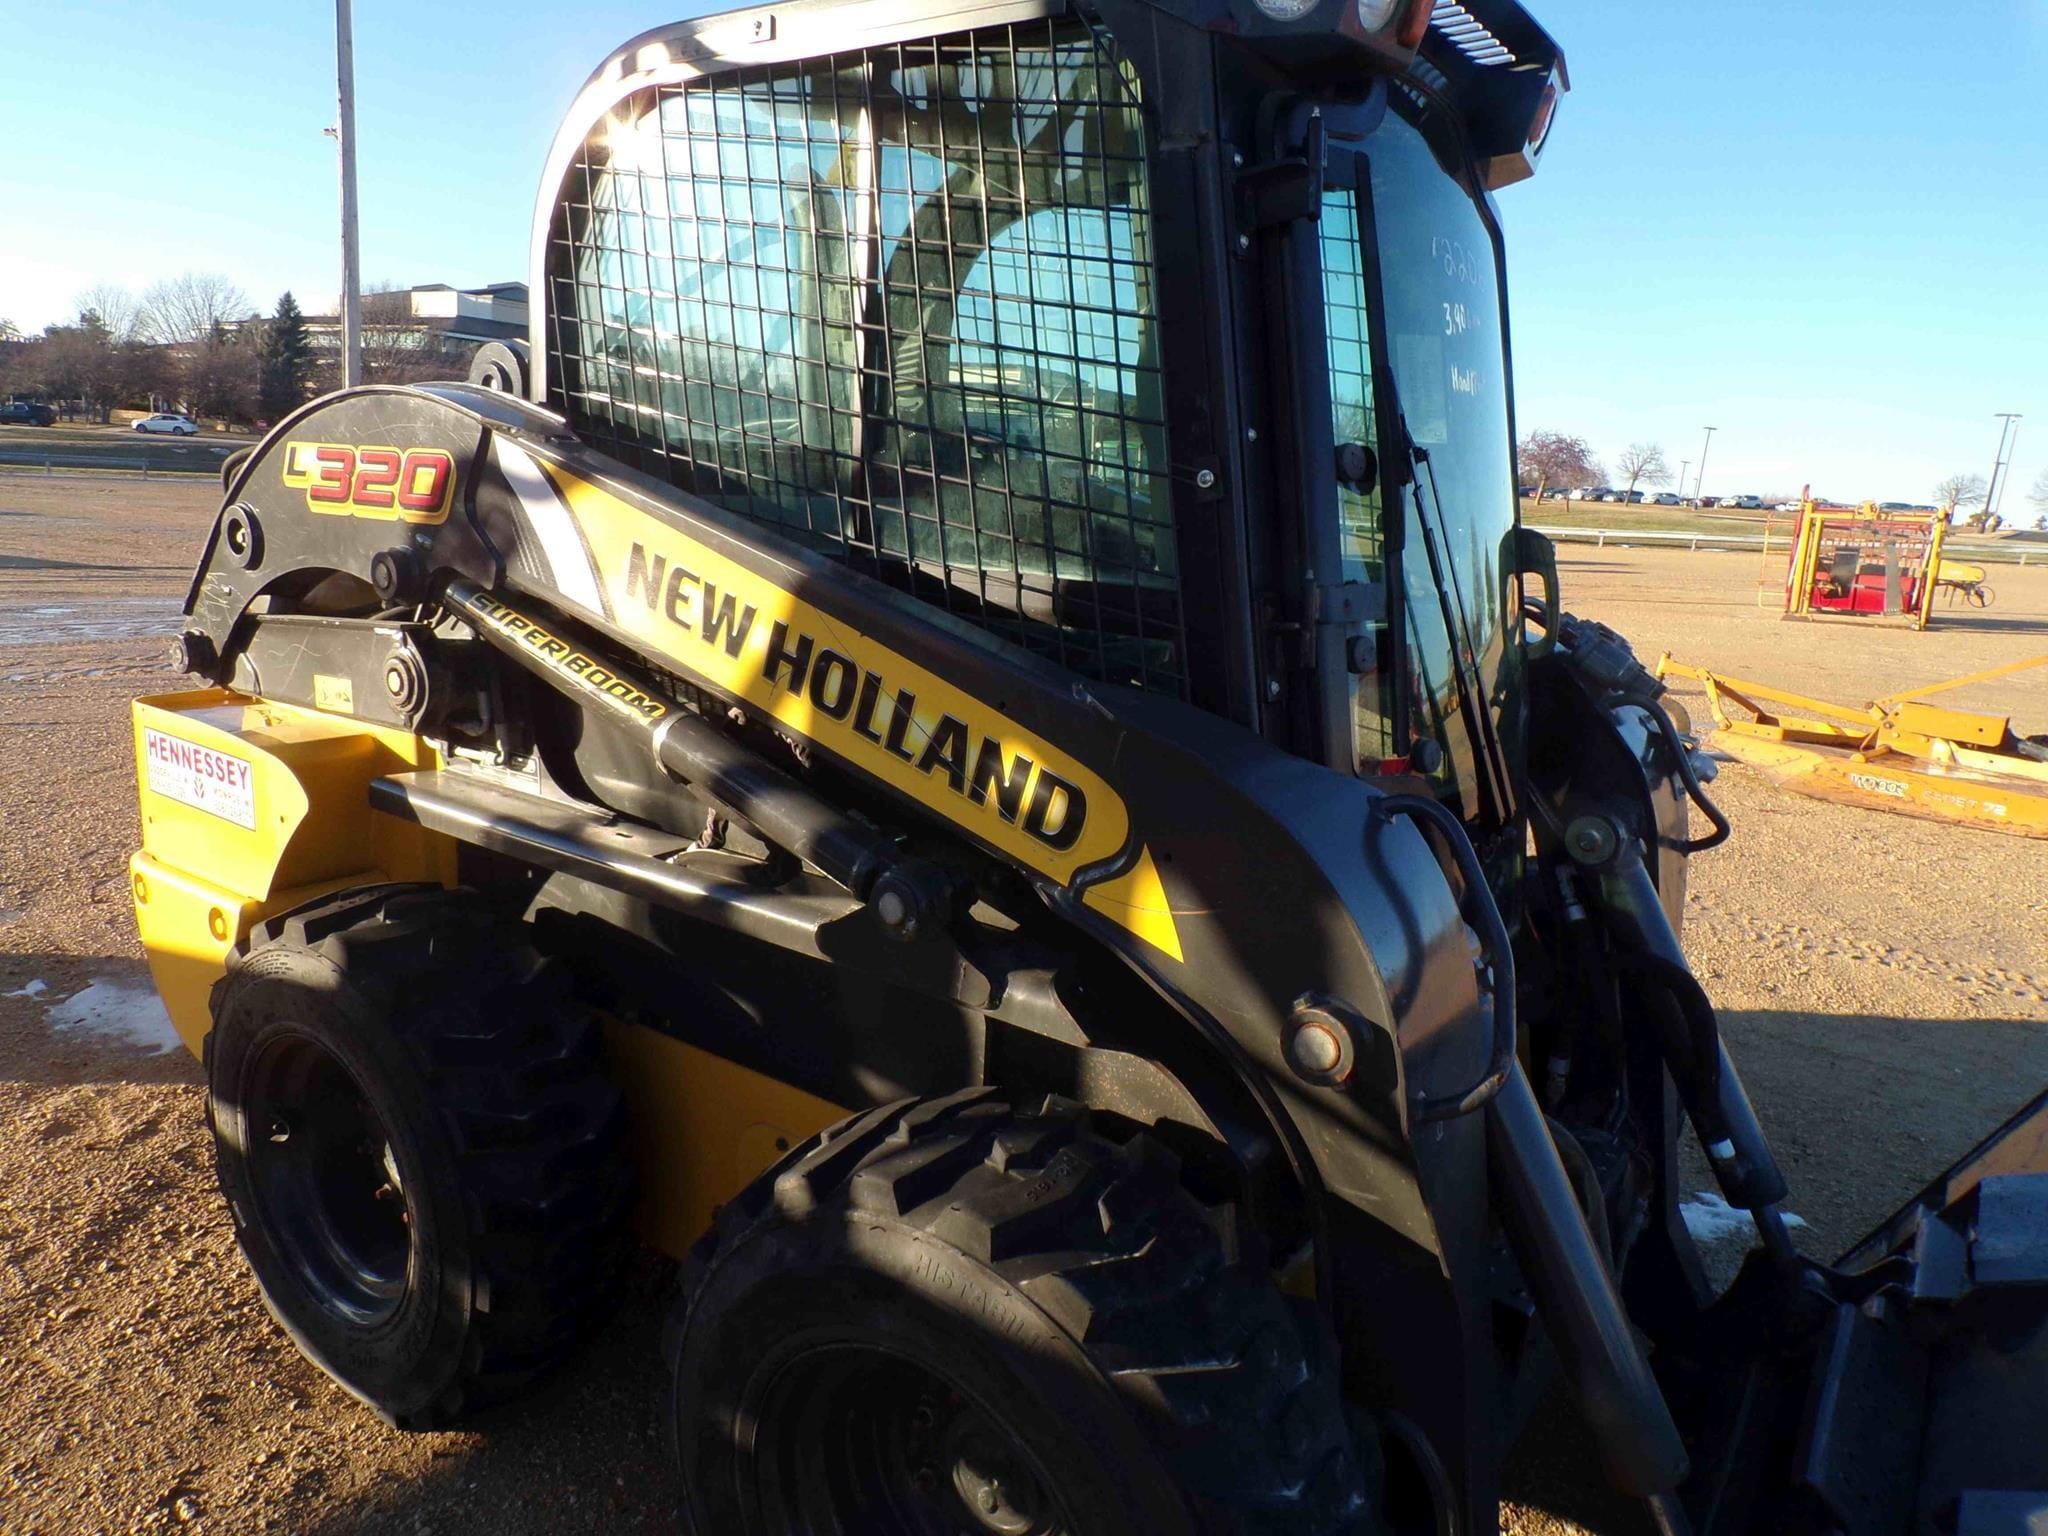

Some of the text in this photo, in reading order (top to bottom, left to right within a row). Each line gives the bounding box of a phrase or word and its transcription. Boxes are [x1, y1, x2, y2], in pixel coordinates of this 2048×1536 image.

[284, 444, 455, 518] L320
[626, 541, 1088, 853] NEW HOLLAND
[147, 732, 248, 790] HENNESSEY
